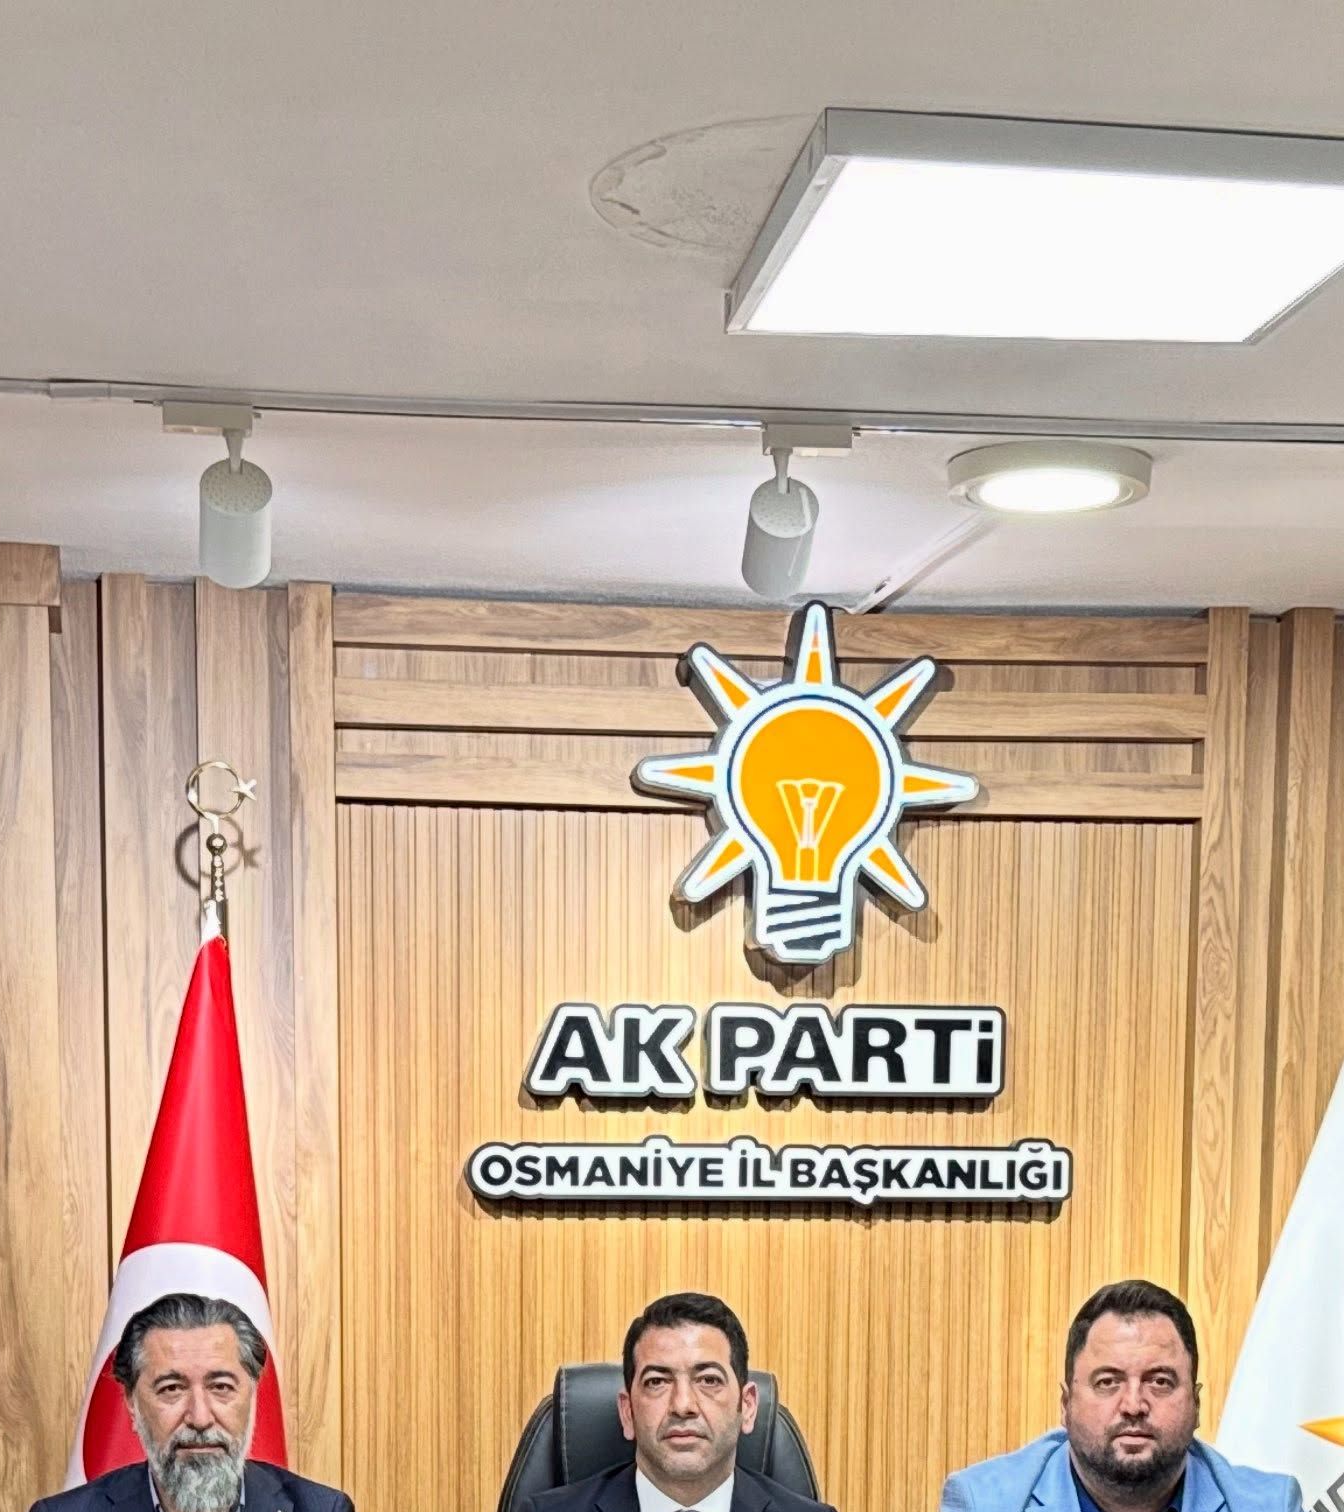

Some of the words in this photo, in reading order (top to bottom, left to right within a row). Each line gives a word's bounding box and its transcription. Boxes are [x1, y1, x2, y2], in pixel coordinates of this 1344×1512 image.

[539, 1015, 688, 1084] AK
[479, 1147, 725, 1188] OSMANİYE
[738, 1148, 776, 1189] İL
[788, 1147, 1063, 1197] BAŞKANLIĞI
